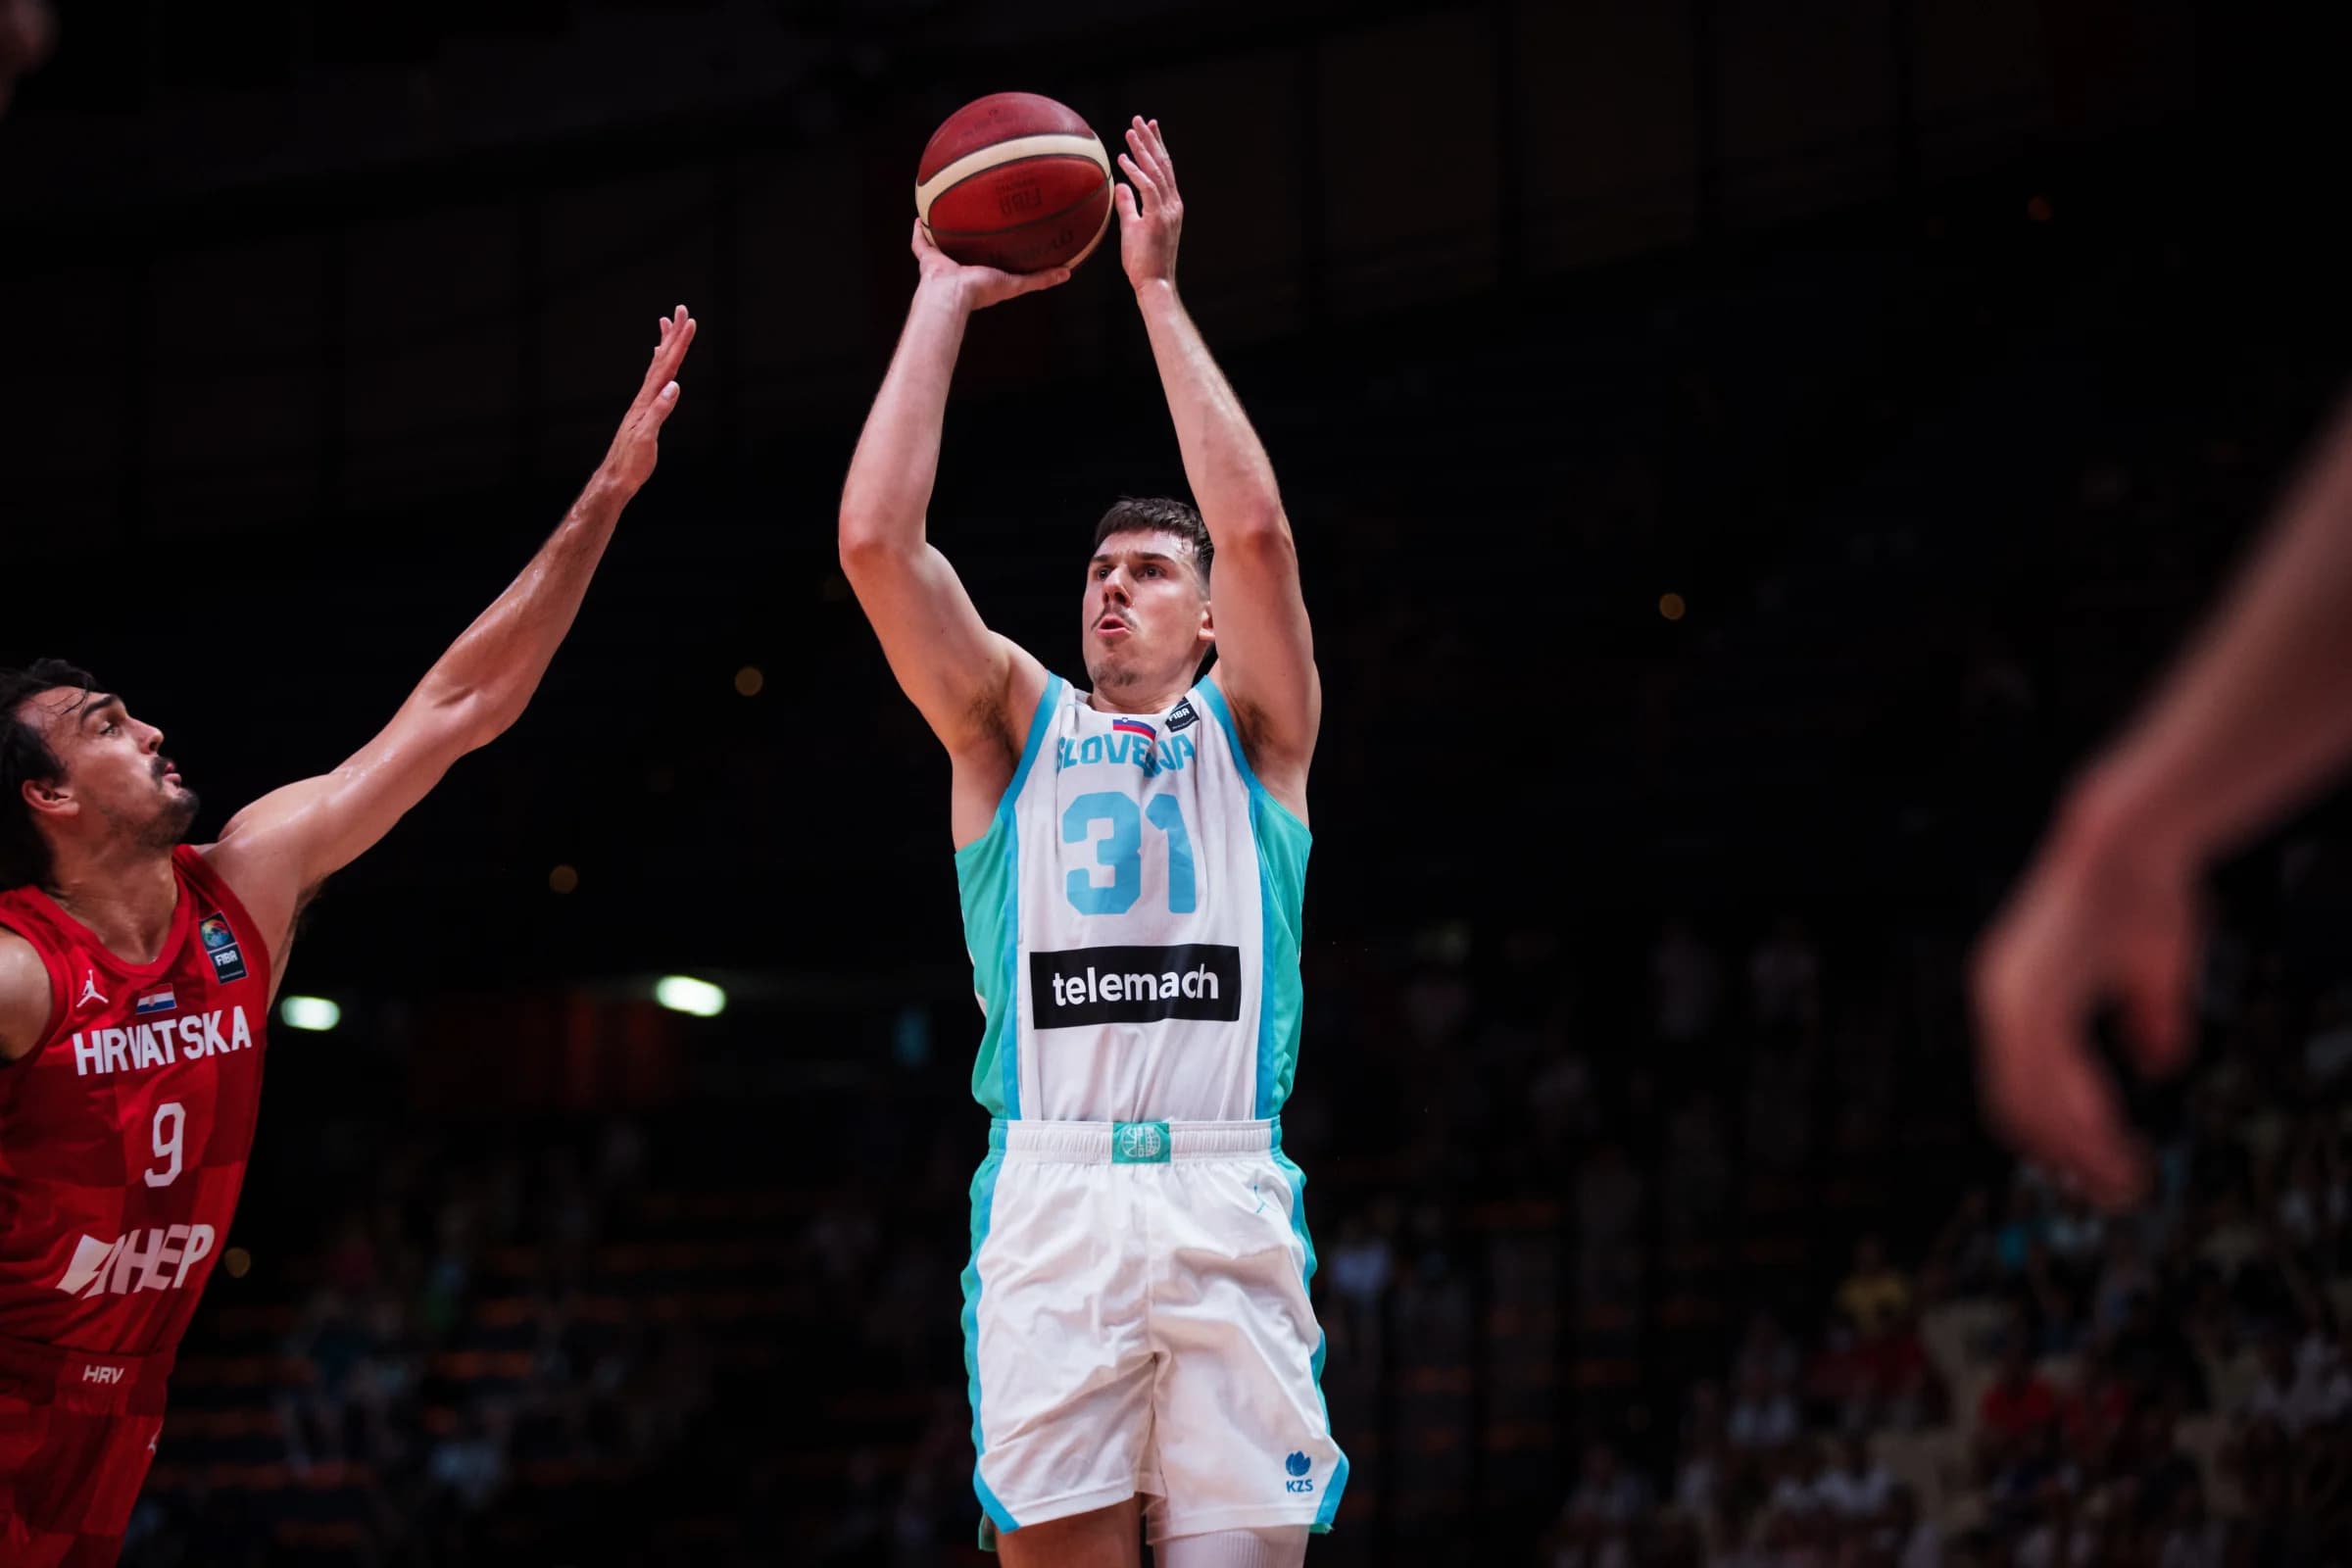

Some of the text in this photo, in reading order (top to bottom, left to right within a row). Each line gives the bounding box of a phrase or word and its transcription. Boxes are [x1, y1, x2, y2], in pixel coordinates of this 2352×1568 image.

[1168, 708, 1190, 722] FIBA
[1062, 792, 1197, 915] 31
[215, 950, 238, 966] FIBA
[1053, 963, 1219, 1006] telemach
[73, 1005, 252, 1076] HRVATSKA
[144, 1102, 185, 1188] 9
[110, 1224, 215, 1295] HEP
[82, 1365, 124, 1384] HRV
[1286, 1479, 1313, 1493] KZS
